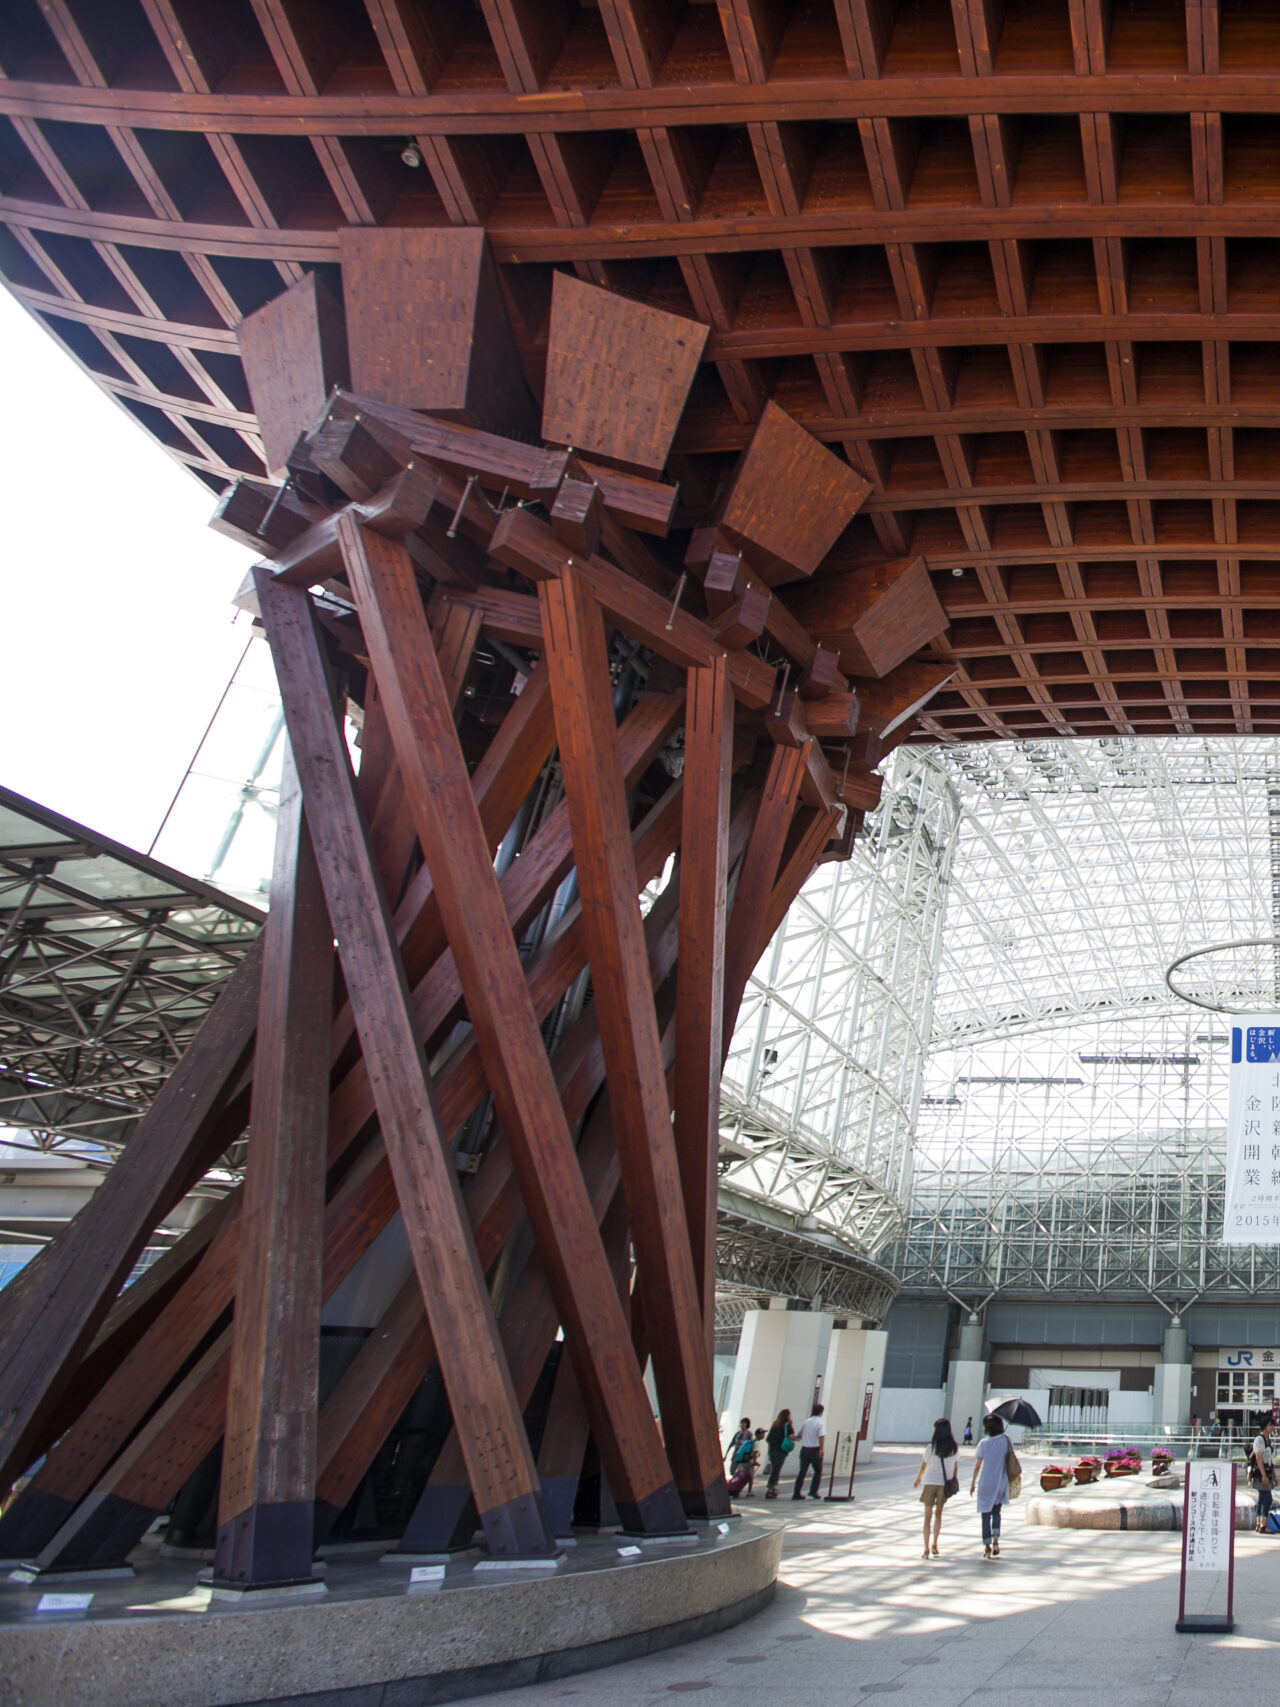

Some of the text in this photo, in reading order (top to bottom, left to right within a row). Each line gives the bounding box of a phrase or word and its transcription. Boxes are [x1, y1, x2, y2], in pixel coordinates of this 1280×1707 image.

[1249, 1029, 1258, 1060] はじまる。
[1267, 1029, 1276, 1051] 新しい
[1244, 1095, 1262, 1187] 金沢開業
[1227, 1350, 1254, 1367] JR
